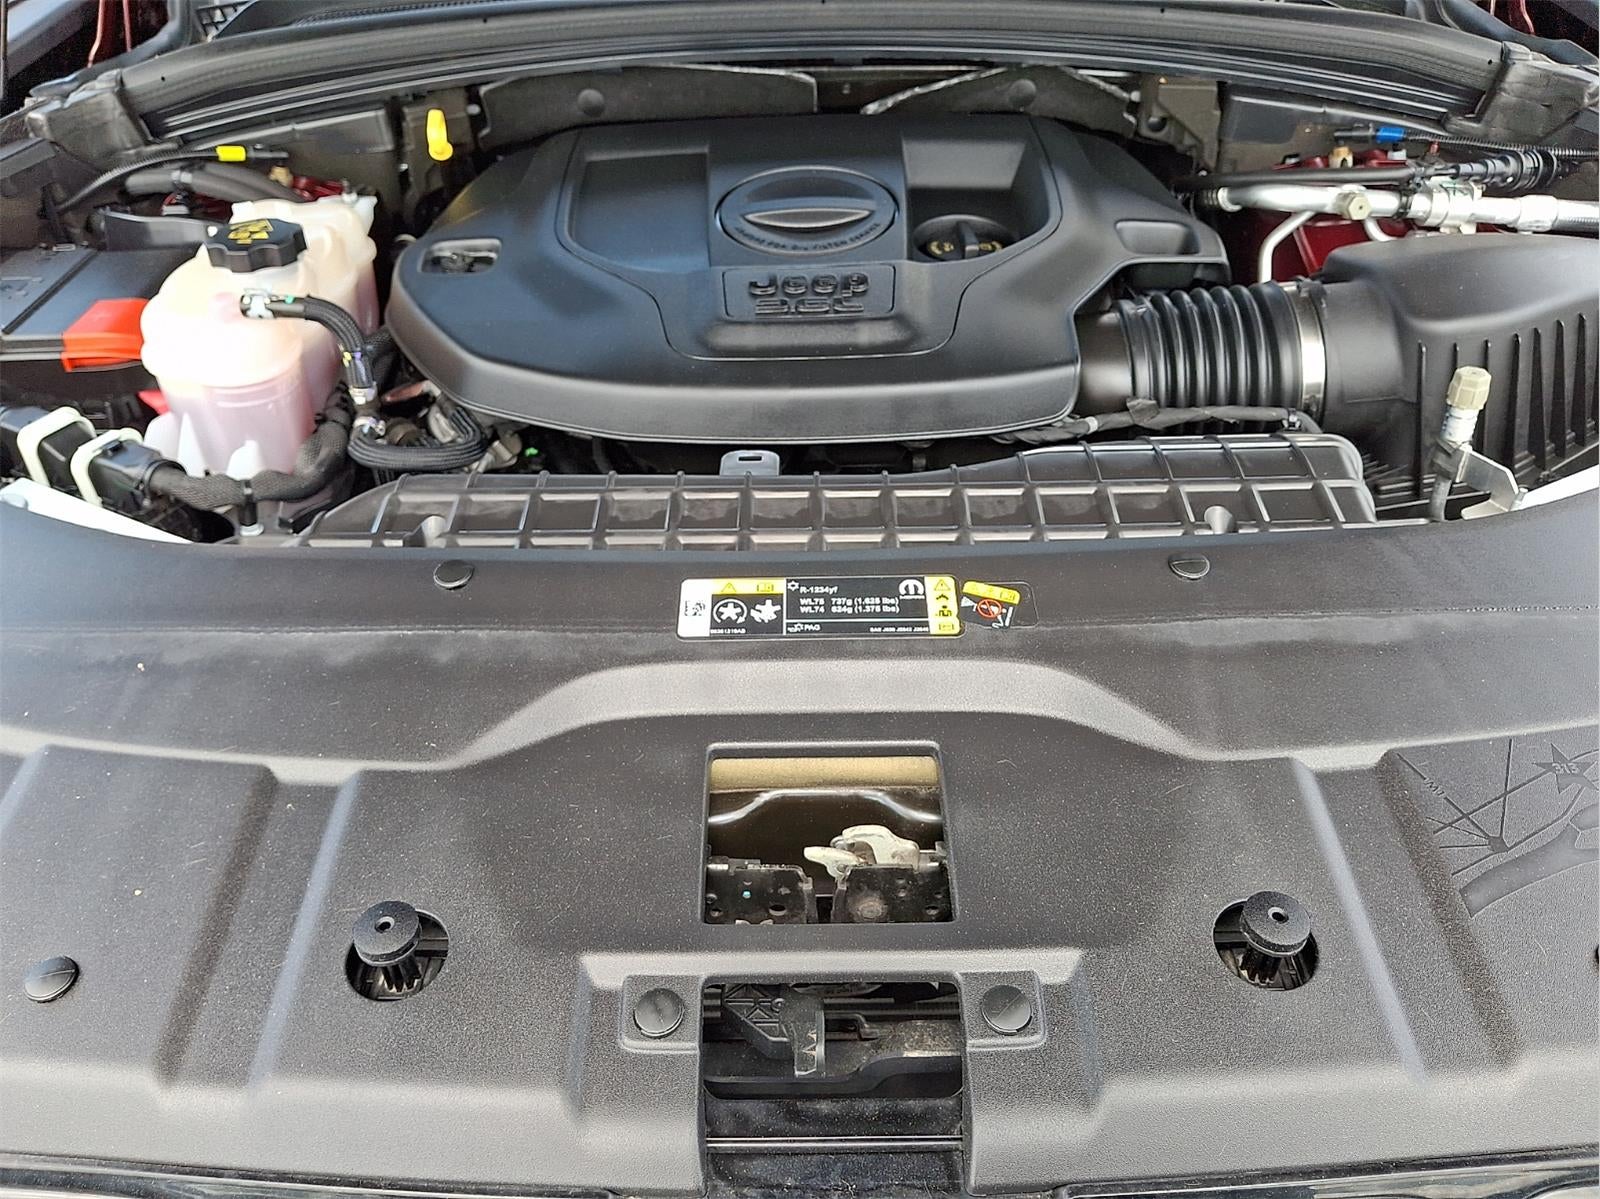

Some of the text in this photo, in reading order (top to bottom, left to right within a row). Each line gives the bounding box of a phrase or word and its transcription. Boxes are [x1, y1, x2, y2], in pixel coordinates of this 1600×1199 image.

[749, 273, 870, 297] Jeep
[799, 586, 838, 595] R-1234yf
[831, 598, 853, 606] 737g
[882, 597, 899, 606] lbs)
[882, 605, 900, 614] lbs)
[1552, 762, 1578, 775] 313
